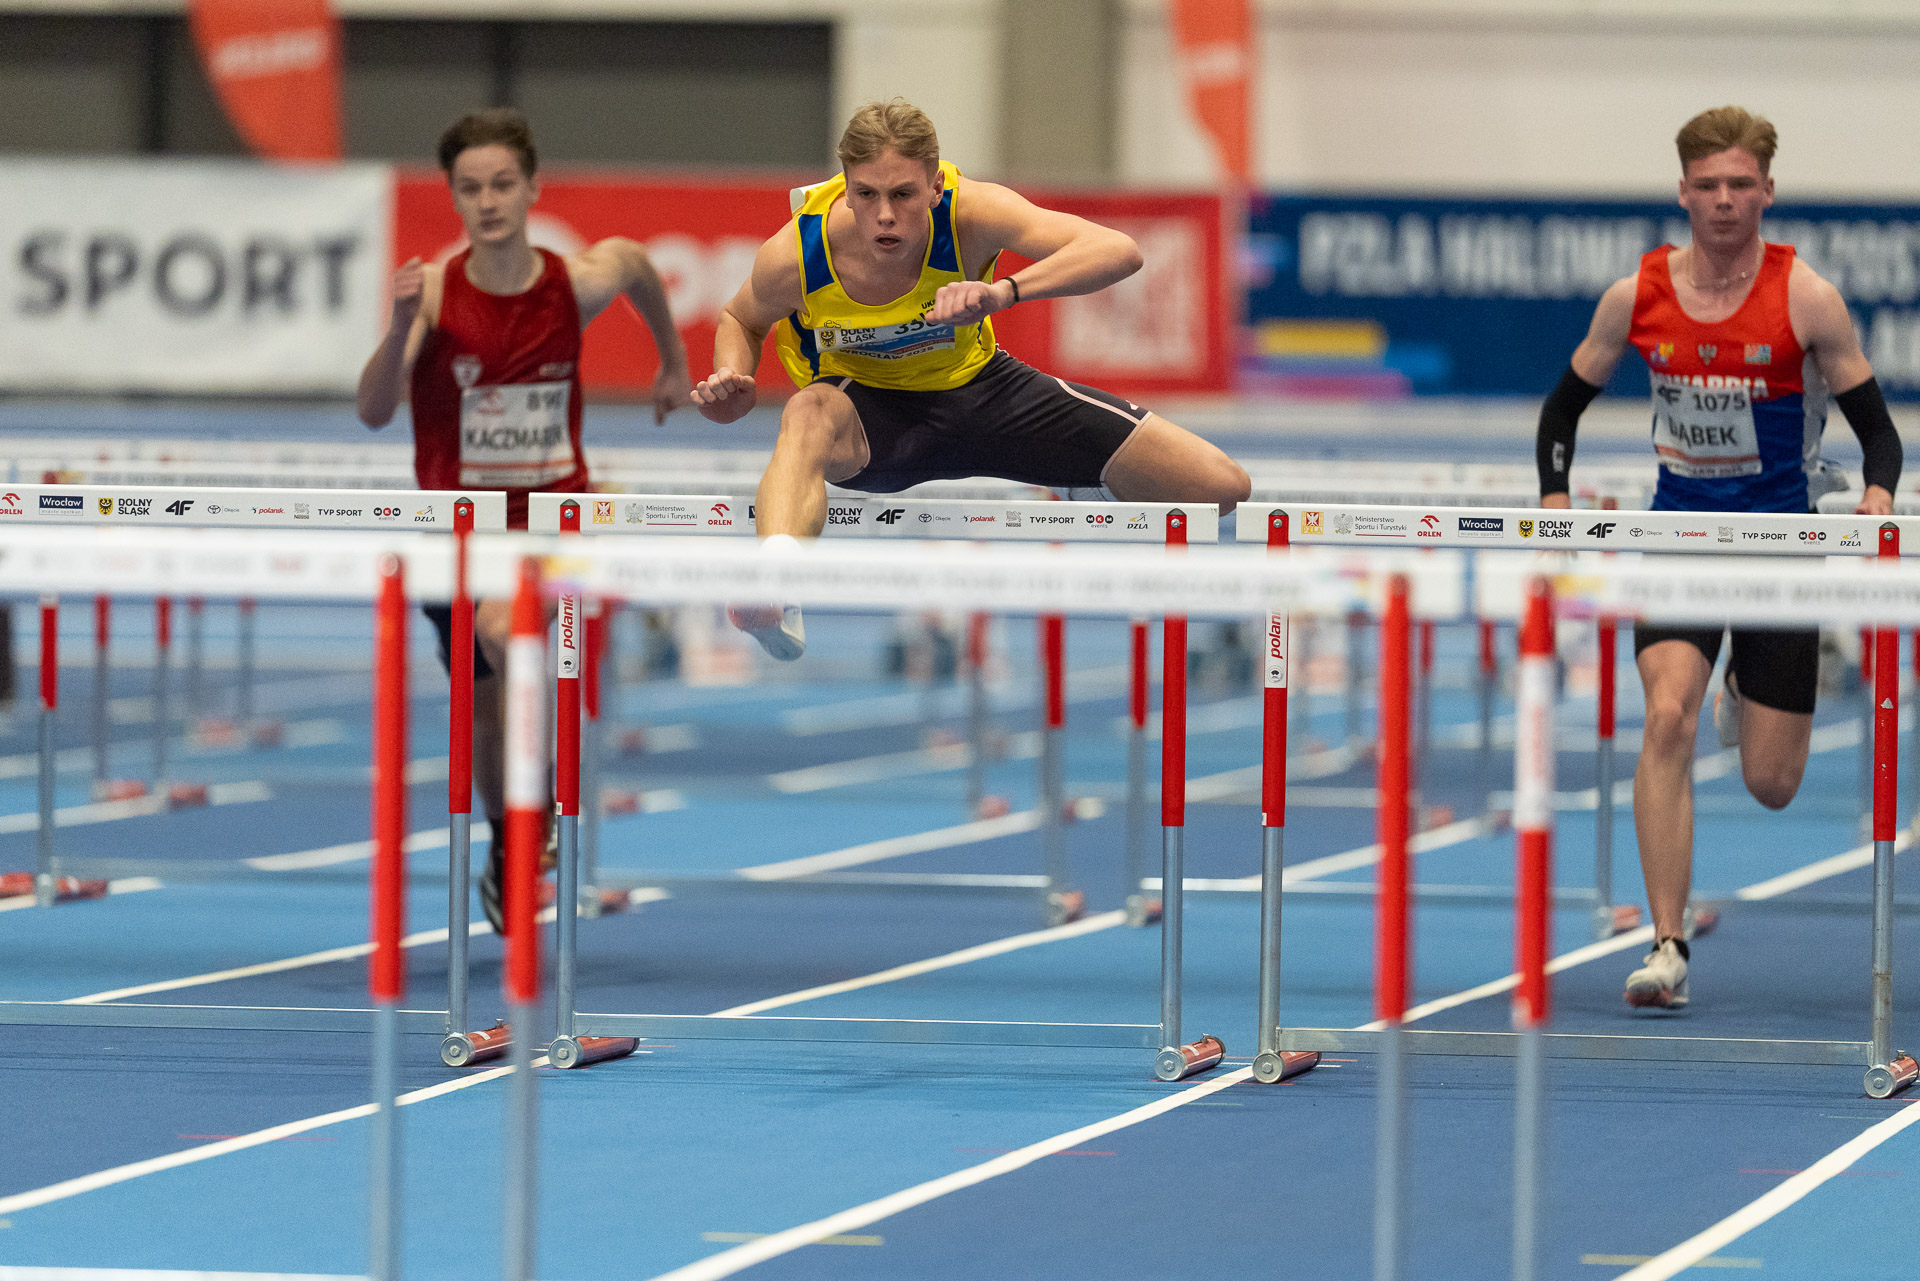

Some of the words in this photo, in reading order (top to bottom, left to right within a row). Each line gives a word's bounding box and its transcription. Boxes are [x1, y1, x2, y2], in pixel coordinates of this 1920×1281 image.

[16, 225, 358, 320] SPORT
[1692, 391, 1746, 411] 1075
[41, 497, 82, 507] Wrocław
[118, 498, 152, 507] DOLNY
[118, 505, 150, 516] ŚLĄSK
[165, 500, 194, 516] 4F
[258, 507, 285, 515] polanik
[318, 508, 334, 516] TVP
[336, 509, 363, 517] SPORT
[828, 507, 863, 516] DOLNY
[646, 512, 666, 520] Sportu
[671, 512, 698, 520] Turystyki
[828, 515, 861, 525] ŚLĄSK
[875, 509, 906, 525] 4F
[970, 515, 996, 523] polanik
[1030, 516, 1046, 524] TVP
[1380, 524, 1407, 532] Turystyki
[1461, 519, 1502, 529] Wrocław
[1539, 520, 1574, 530] DOLNY
[1417, 530, 1442, 538] ORLEN
[1539, 528, 1571, 539] ŚLĄSK
[1586, 523, 1617, 538] 4F
[1681, 530, 1708, 538] polanik
[1742, 532, 1759, 540] TVP
[1760, 533, 1788, 541] SPORT
[561, 592, 576, 650] polanik
[1268, 608, 1284, 660] polani
